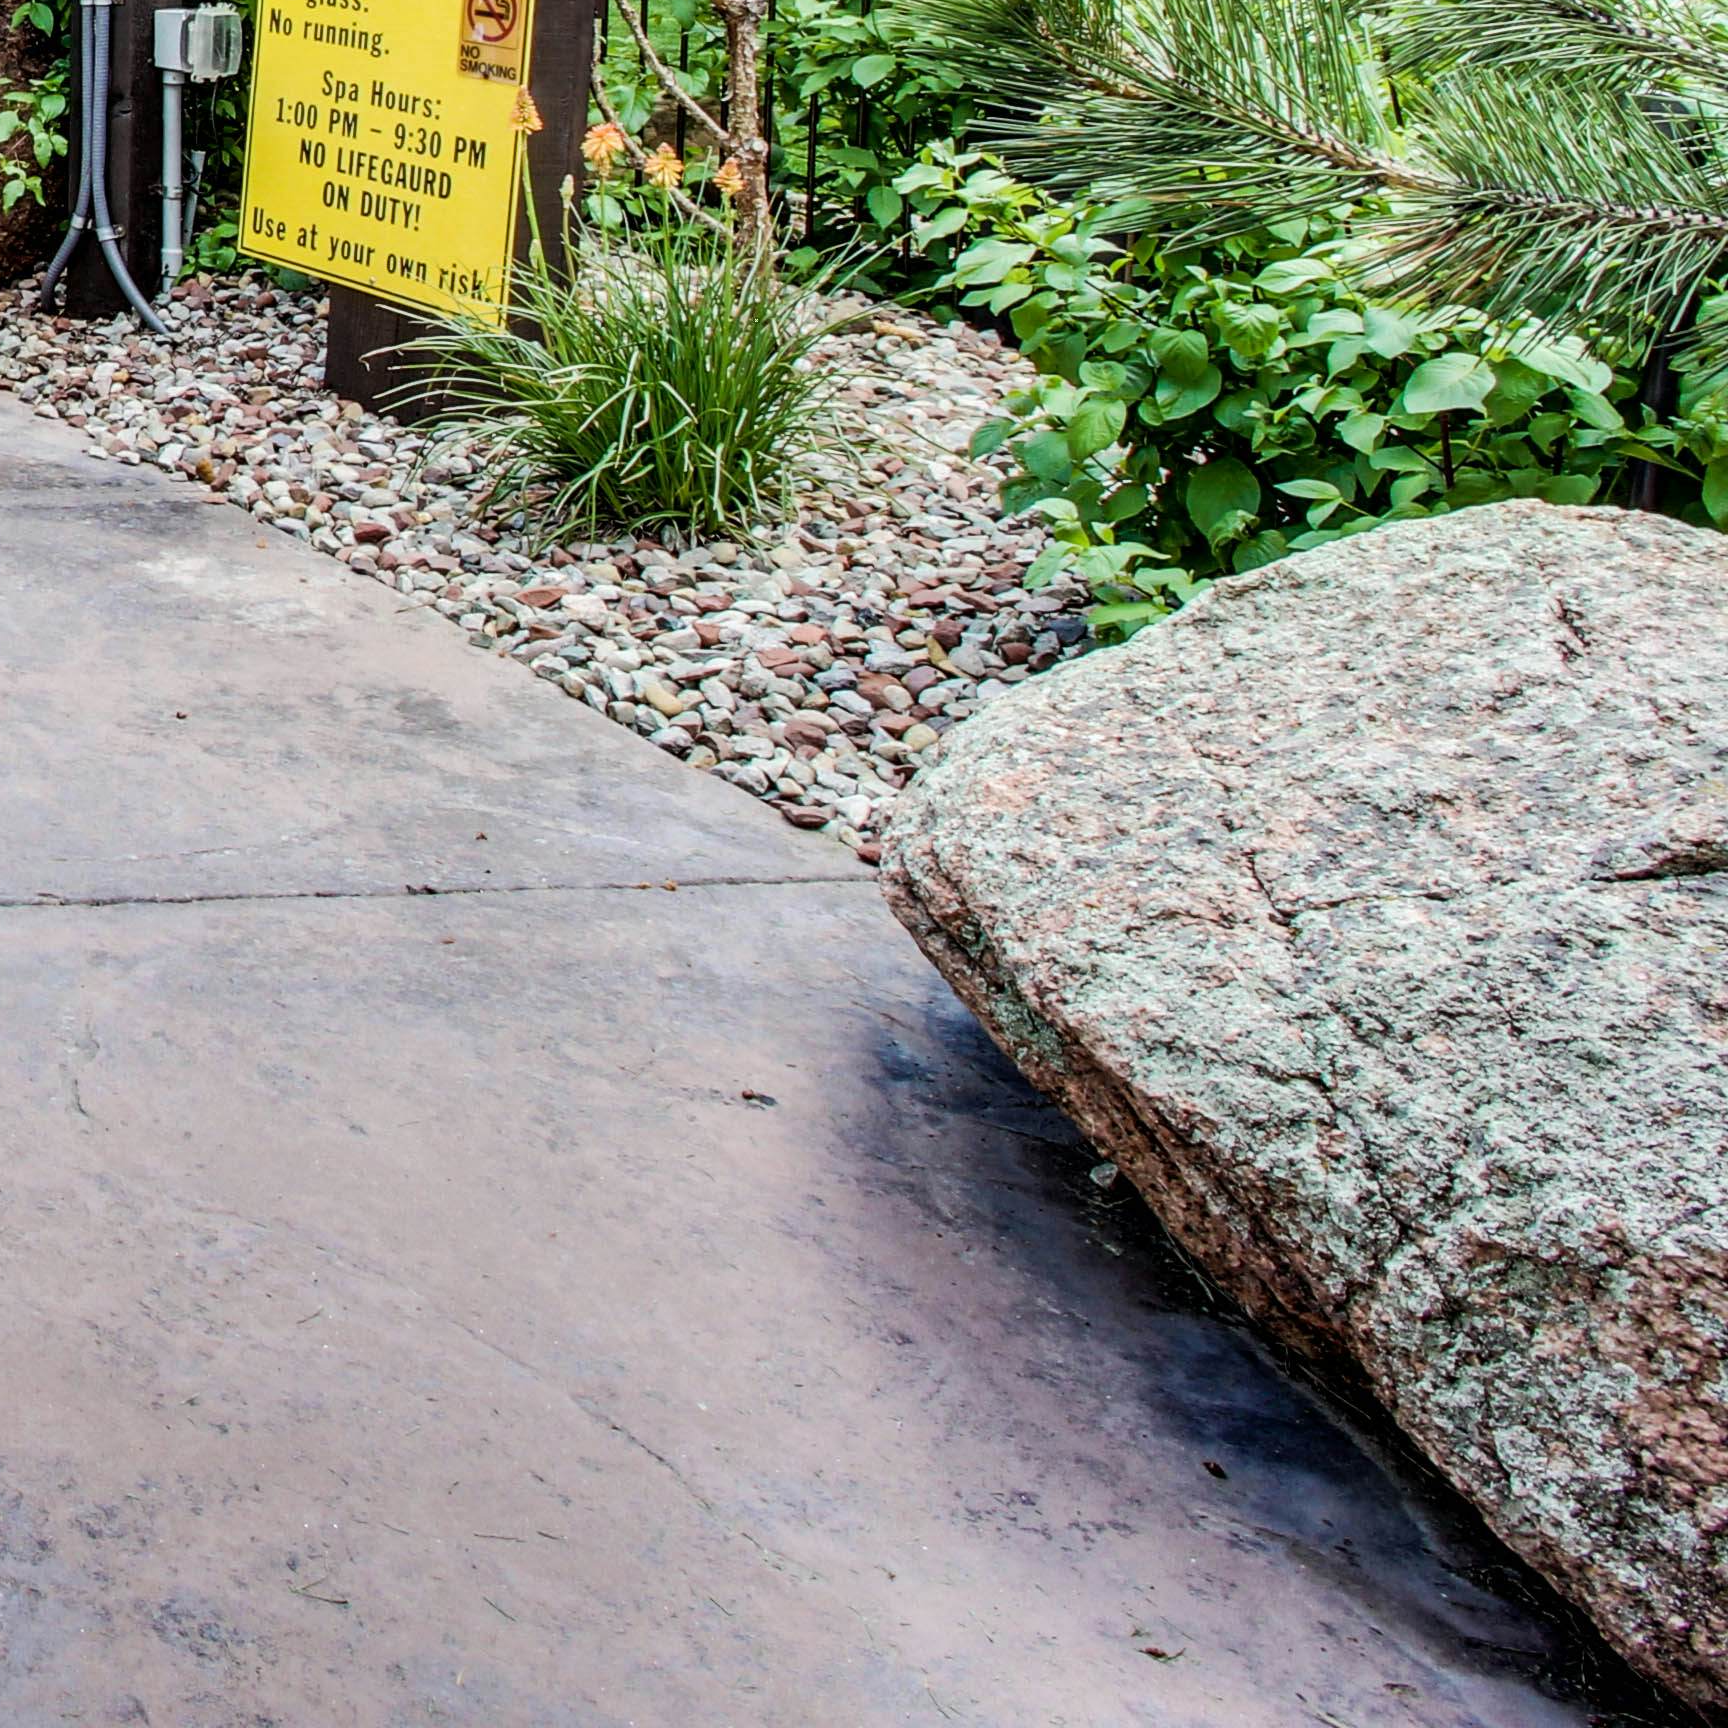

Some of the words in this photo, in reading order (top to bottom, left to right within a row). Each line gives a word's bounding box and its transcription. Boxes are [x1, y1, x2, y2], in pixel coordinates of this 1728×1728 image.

[269, 9, 293, 36] No
[303, 20, 390, 57] running.
[461, 45, 480, 59] NO
[459, 59, 517, 80] SMOKING
[322, 70, 359, 102] Spa
[371, 80, 442, 120] Hours:
[276, 98, 318, 129] 1:00
[328, 109, 359, 139] PM
[394, 123, 442, 159] 9:30
[454, 136, 487, 169] PM
[299, 138, 326, 168] NO
[336, 147, 452, 200] LIFEGAURD
[322, 181, 349, 211] ON
[360, 194, 421, 231] DUTY!
[253, 207, 287, 241] Use
[297, 223, 318, 251] at
[327, 235, 376, 267] your
[386, 253, 428, 282] own
